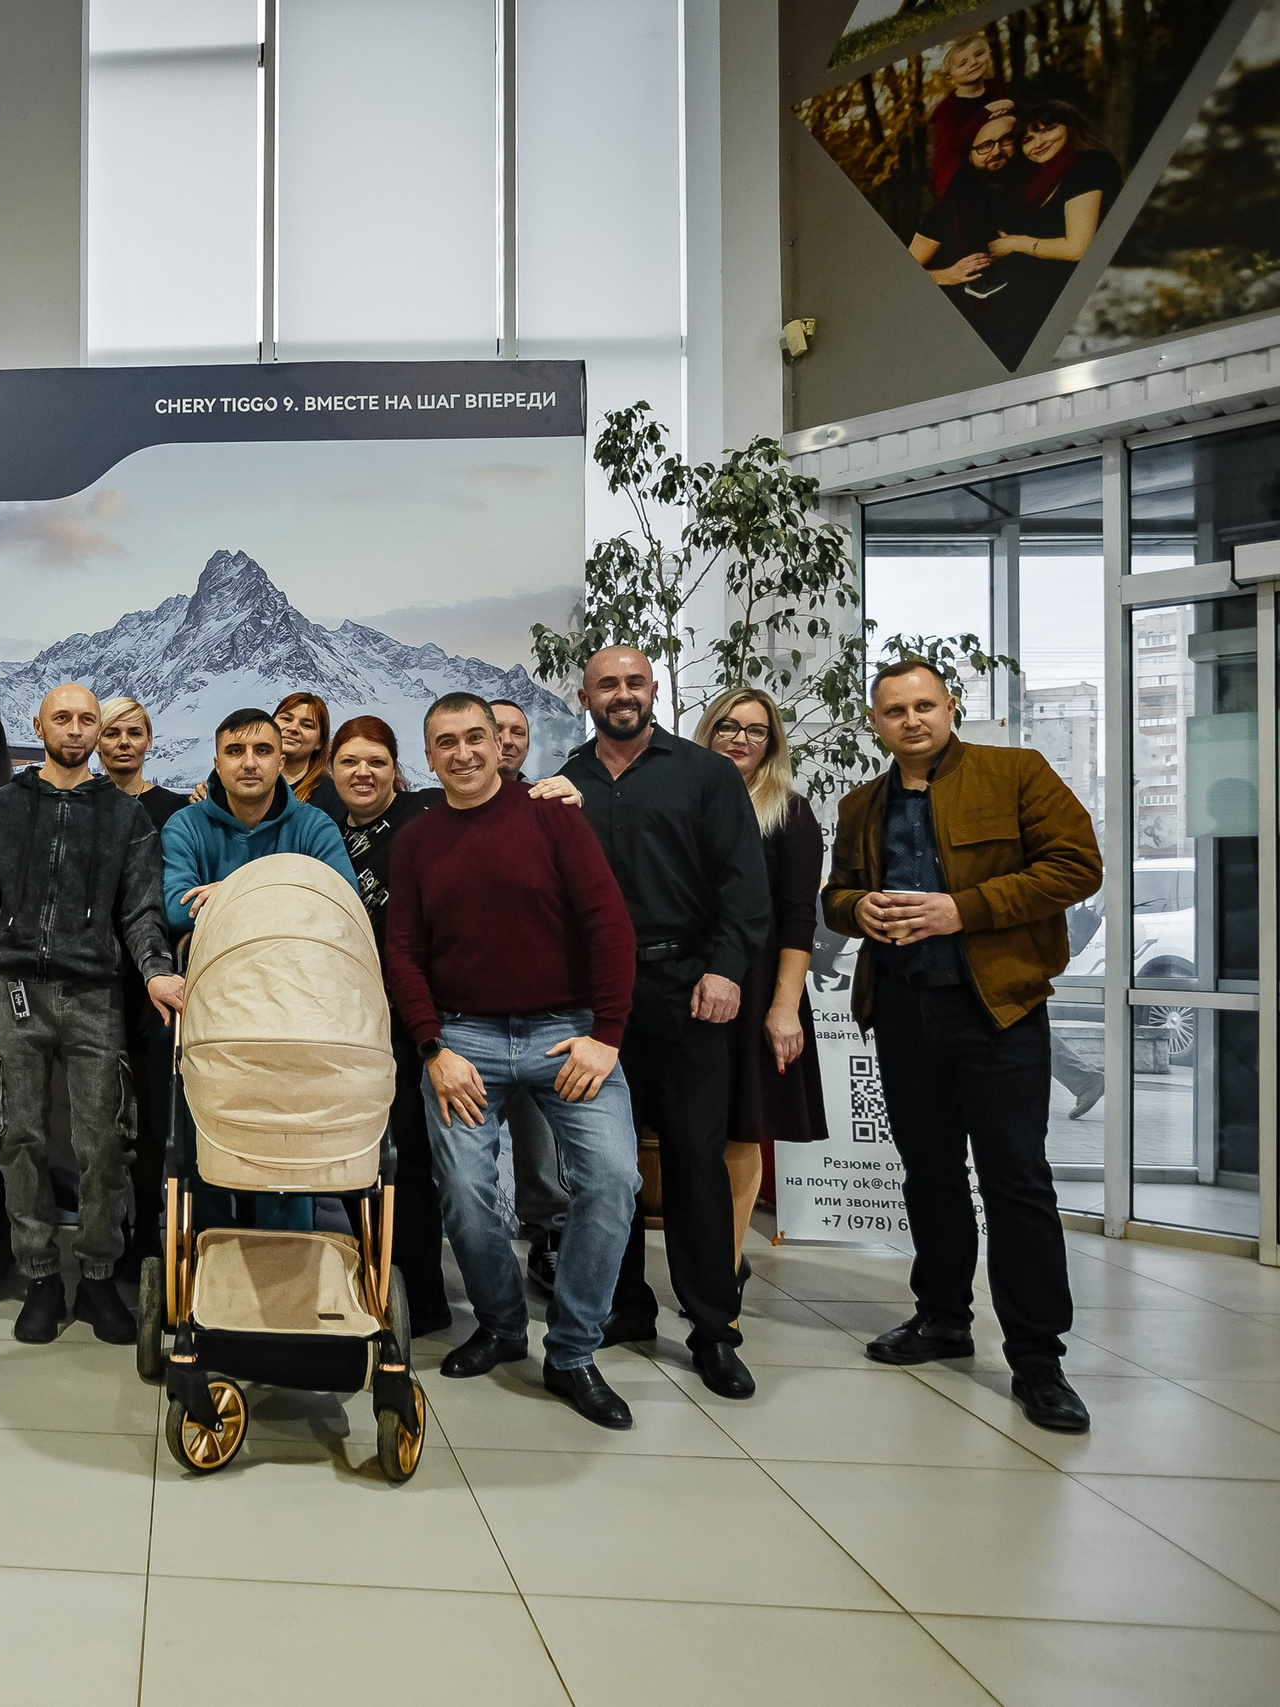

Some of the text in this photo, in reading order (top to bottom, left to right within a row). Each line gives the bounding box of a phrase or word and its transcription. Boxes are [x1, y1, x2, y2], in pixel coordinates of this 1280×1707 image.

[154, 391, 556, 414] CHERY TIGGO 9. ВМЕСТЕ НА ШАГ ВПЕРЕДИ
[816, 1030, 860, 1041] авайте
[823, 1156, 906, 1172] Резюме от
[786, 1176, 902, 1191] на почту ok@ch
[814, 1197, 907, 1210] или звоните
[821, 1214, 910, 1232] +7 (978) 6
